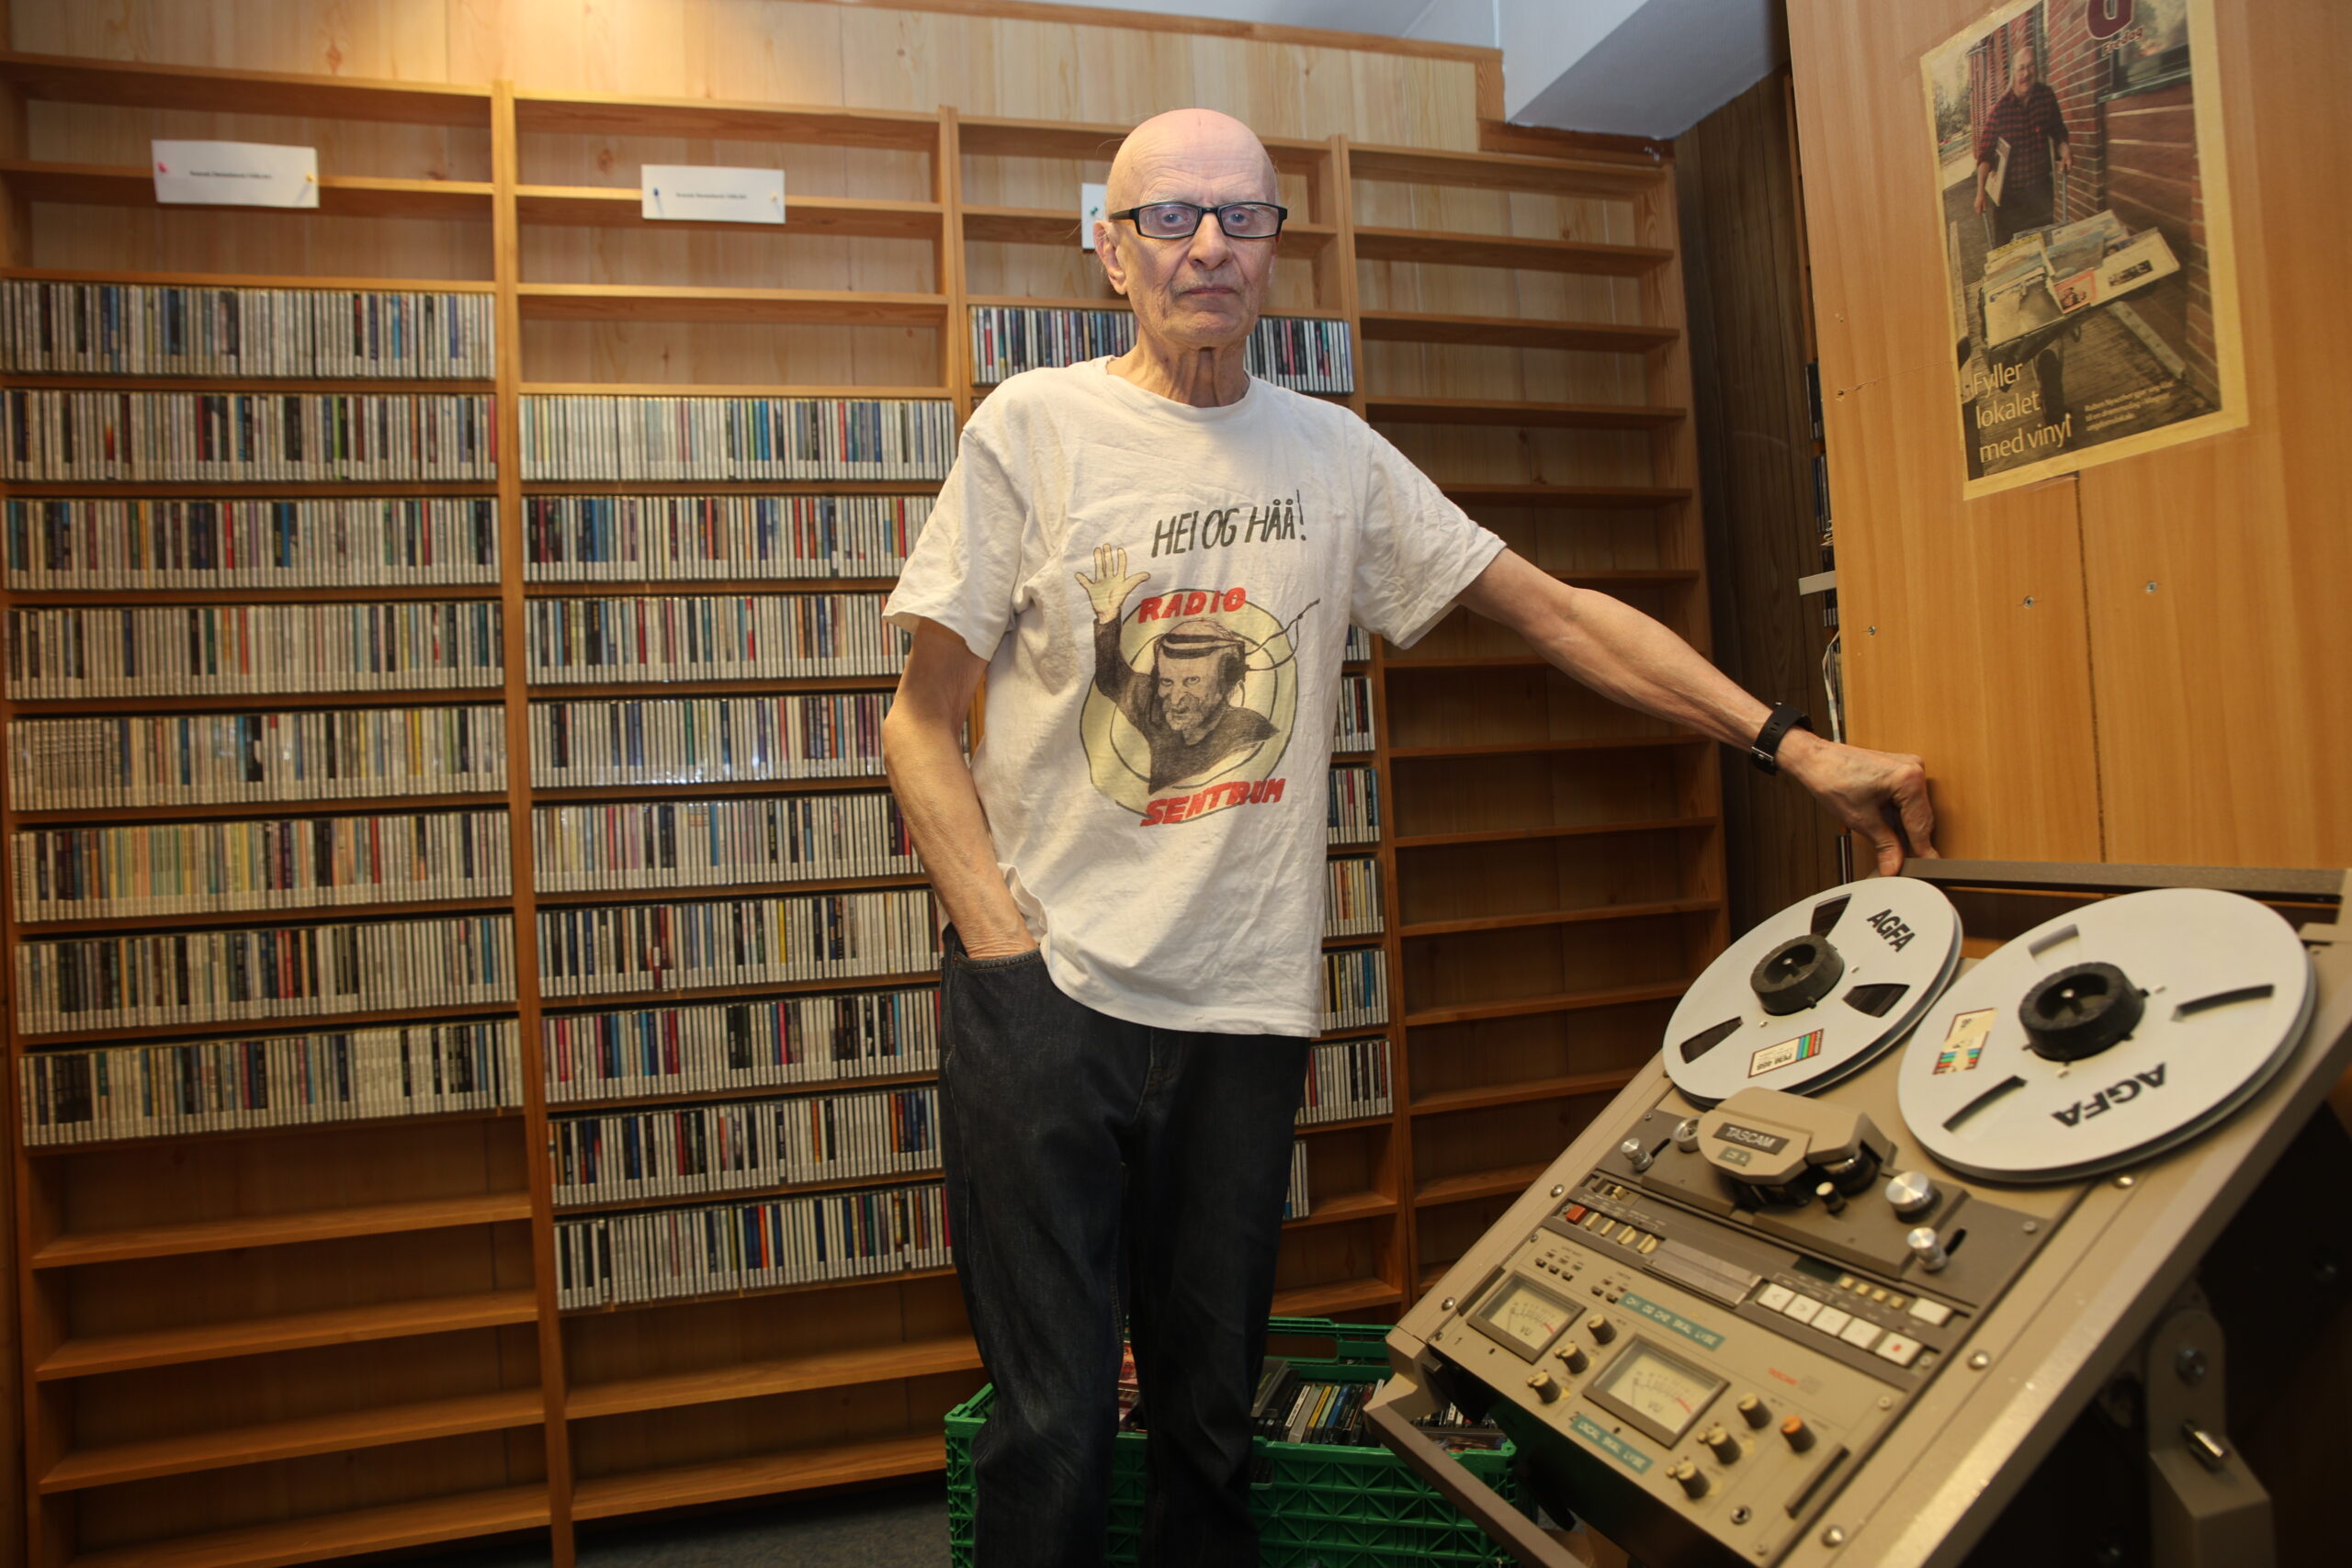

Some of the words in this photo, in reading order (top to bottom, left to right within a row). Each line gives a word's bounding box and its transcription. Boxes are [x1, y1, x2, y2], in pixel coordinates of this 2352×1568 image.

[1973, 363, 2023, 398] Fyller
[1976, 390, 2041, 429] lokalet
[1980, 428, 2024, 463] med
[2027, 412, 2072, 448] vinyl
[1151, 511, 1199, 558] HEI
[1202, 508, 1239, 549] OG
[1244, 490, 1306, 543] HÅÅ!
[1137, 587, 1246, 623] RADIO
[1140, 778, 1285, 827] SENTRUM
[1867, 908, 1915, 953] AGFA
[2051, 1062, 2165, 1127] AGFA
[1725, 1126, 1776, 1148] TASCAM
